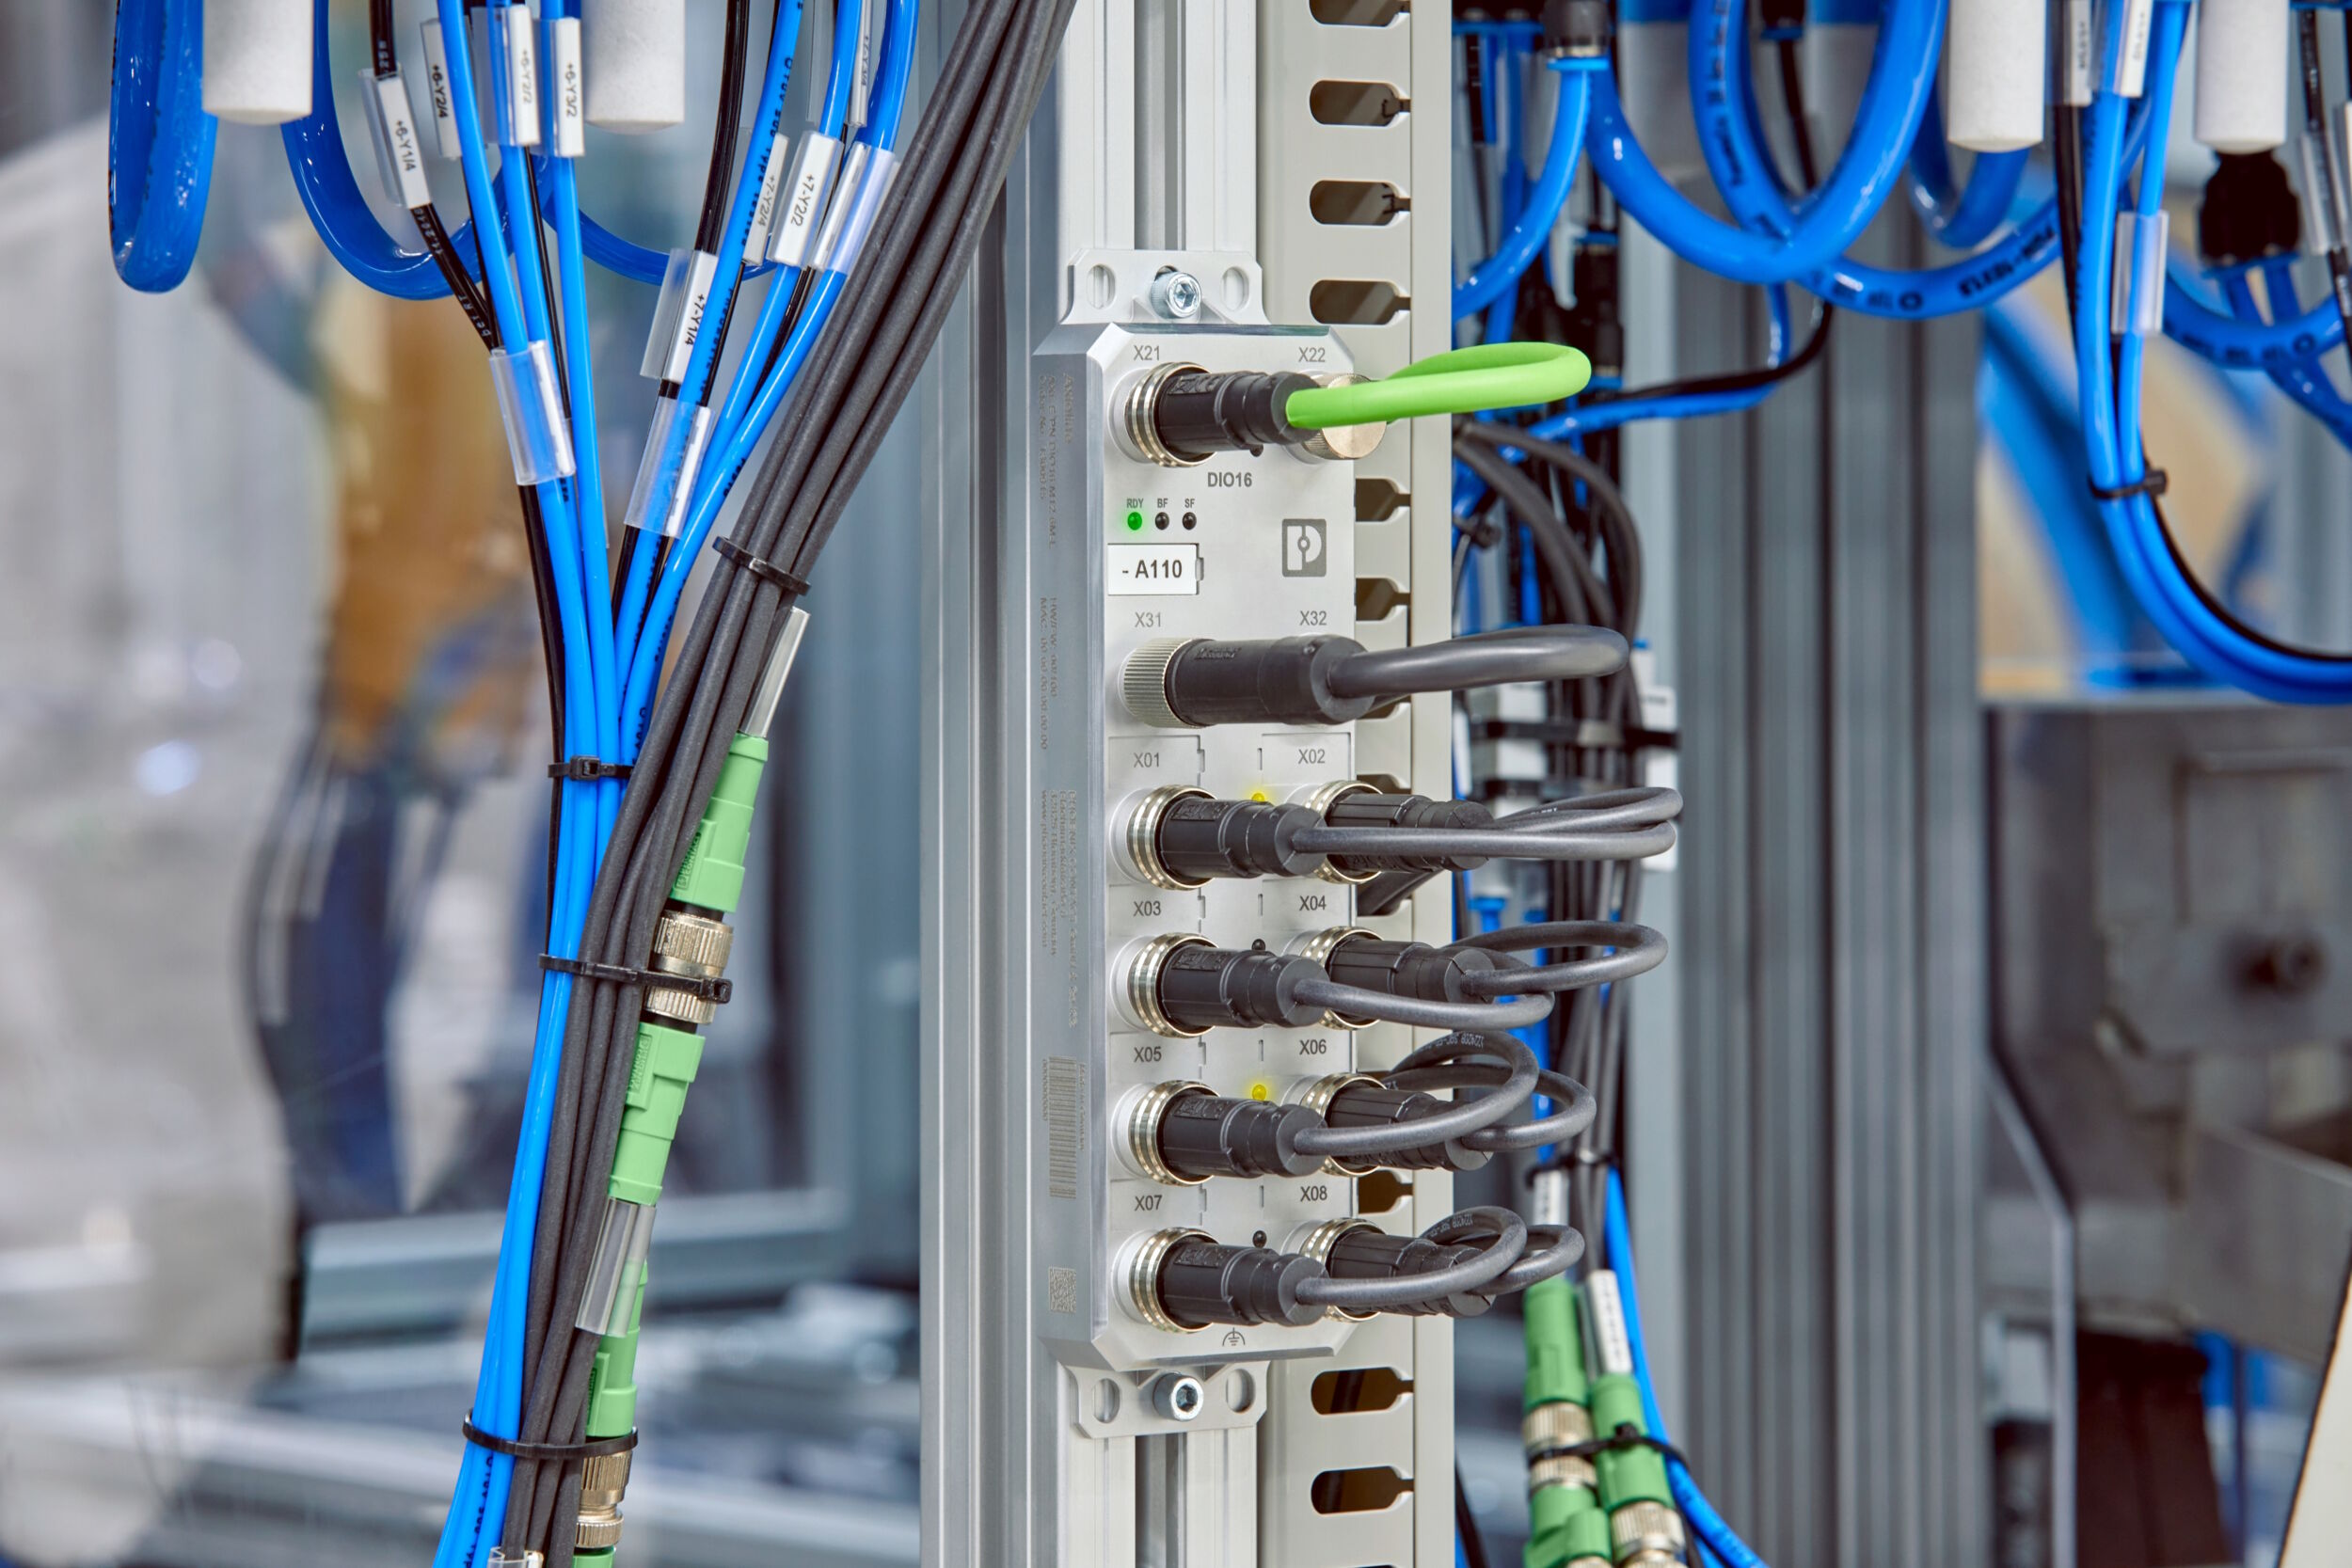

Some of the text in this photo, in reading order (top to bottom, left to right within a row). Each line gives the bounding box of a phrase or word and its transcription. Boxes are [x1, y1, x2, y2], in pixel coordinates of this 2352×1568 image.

[431, 65, 449, 119] +6-Y2/4
[564, 63, 578, 119] +6-Y3/2
[395, 120, 417, 172] +6-Y1/4
[757, 175, 775, 228] +7-Y2/4
[790, 174, 815, 228] +7-Y2/2
[1133, 345, 1160, 360] X21
[1298, 347, 1326, 363] X22
[1208, 471, 1253, 488] DIO16
[1126, 498, 1144, 509] RDY
[1156, 498, 1168, 509] BF
[1184, 498, 1196, 509] SF
[1135, 559, 1183, 578] A110
[1135, 611, 1161, 627] X31
[1299, 610, 1327, 626] X32
[1134, 752, 1160, 768] X01
[1298, 749, 1326, 764] X02
[1134, 900, 1161, 916] X03
[1299, 895, 1327, 911] X04
[1134, 1045, 1162, 1062] X05
[1298, 1038, 1327, 1055] X06
[1299, 1185, 1327, 1202] X08
[1135, 1194, 1163, 1211] X07
